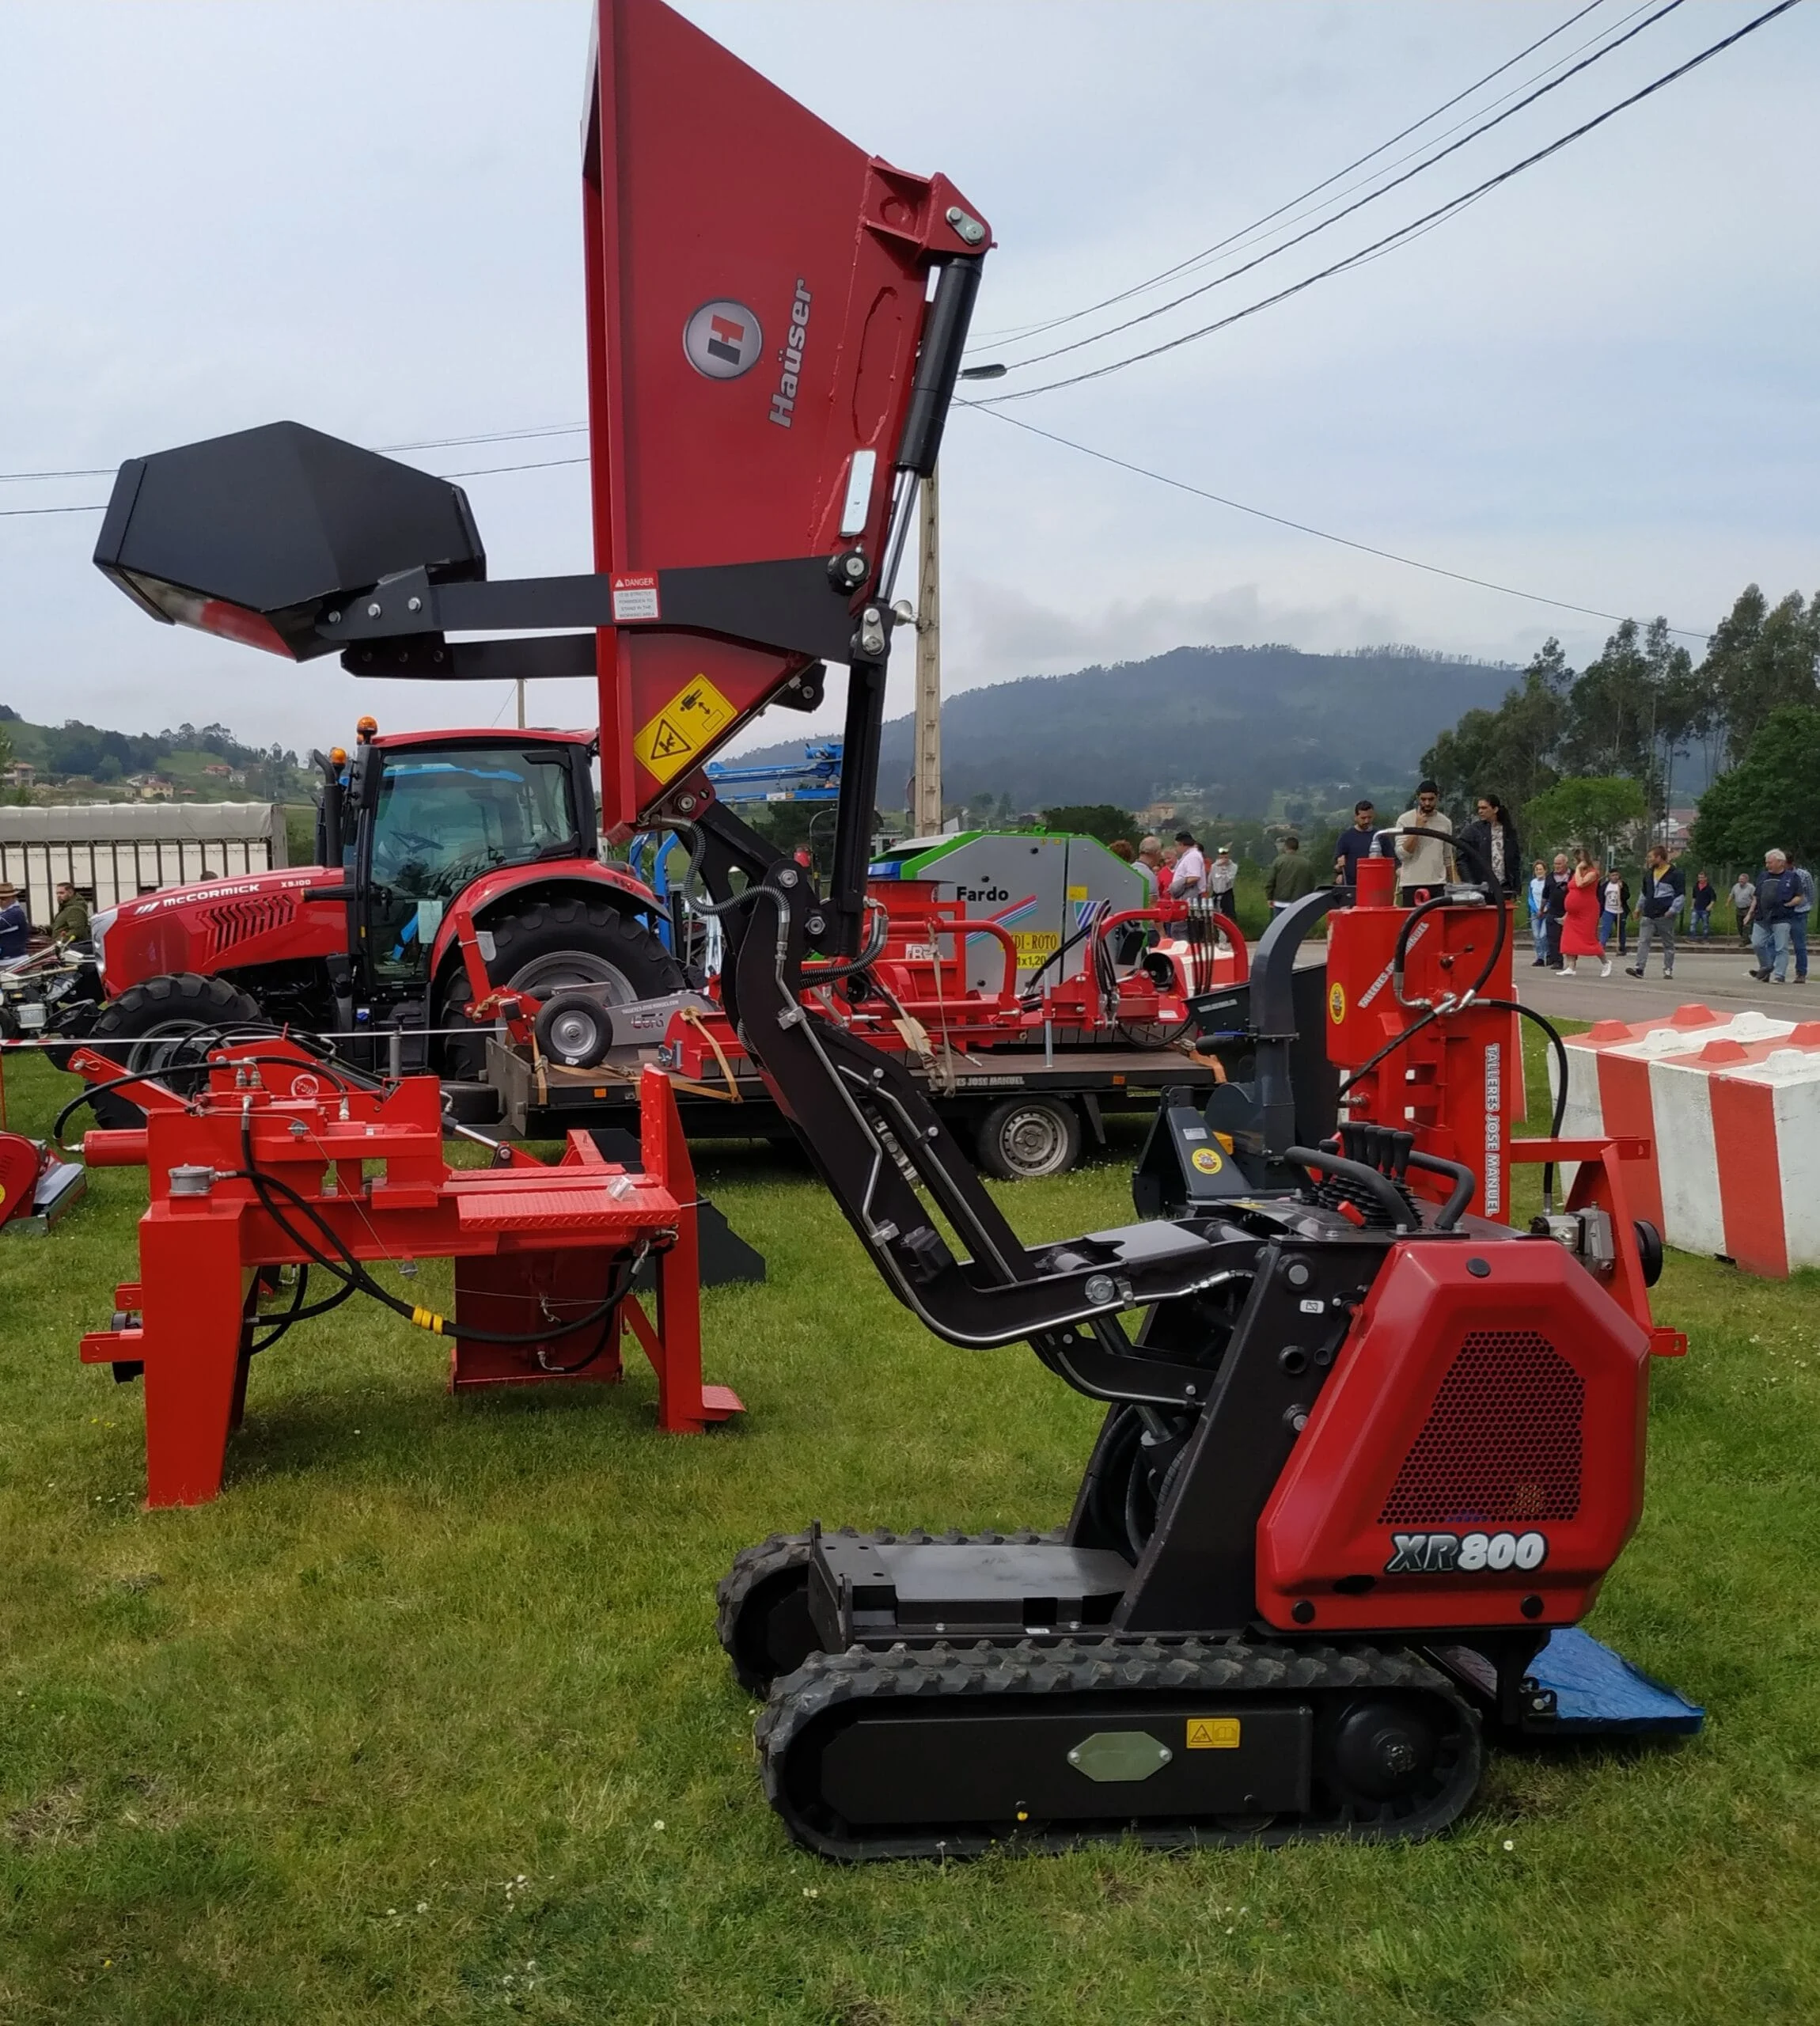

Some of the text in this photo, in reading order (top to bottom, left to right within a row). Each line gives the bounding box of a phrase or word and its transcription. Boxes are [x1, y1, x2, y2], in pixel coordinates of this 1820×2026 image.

[768, 279, 812, 428] Haüser
[624, 578, 654, 586] DANGER
[957, 886, 1009, 901] Fardo
[1032, 935, 1057, 949] ROTO
[1485, 1043, 1500, 1217] TALLERES JOSE MANUEL
[1386, 1532, 1546, 1572] XR800
